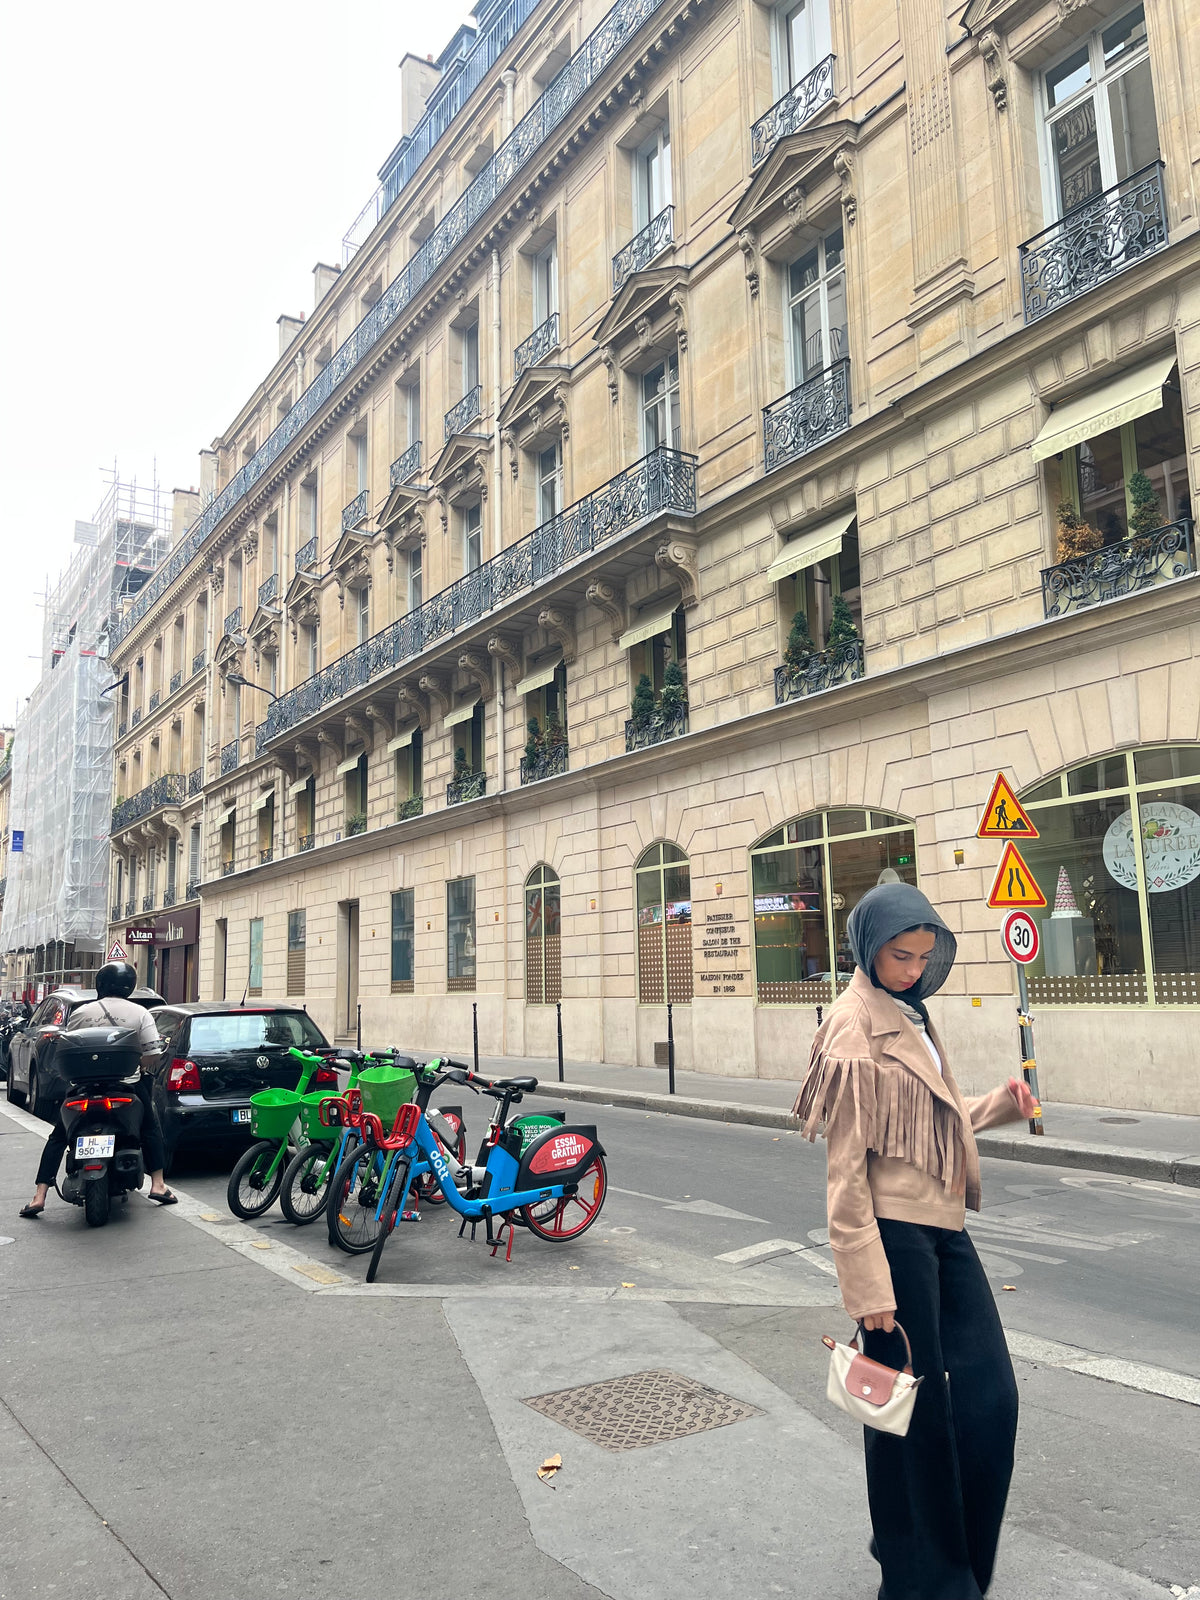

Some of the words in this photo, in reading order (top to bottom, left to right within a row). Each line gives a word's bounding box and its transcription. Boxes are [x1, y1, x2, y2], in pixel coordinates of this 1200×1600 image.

[1111, 806, 1195, 836] CASBLANCA
[1013, 925, 1030, 949] 30
[704, 950, 738, 958] RESTAURANT
[554, 1136, 577, 1149] ESSAI
[430, 1150, 450, 1181] dott
